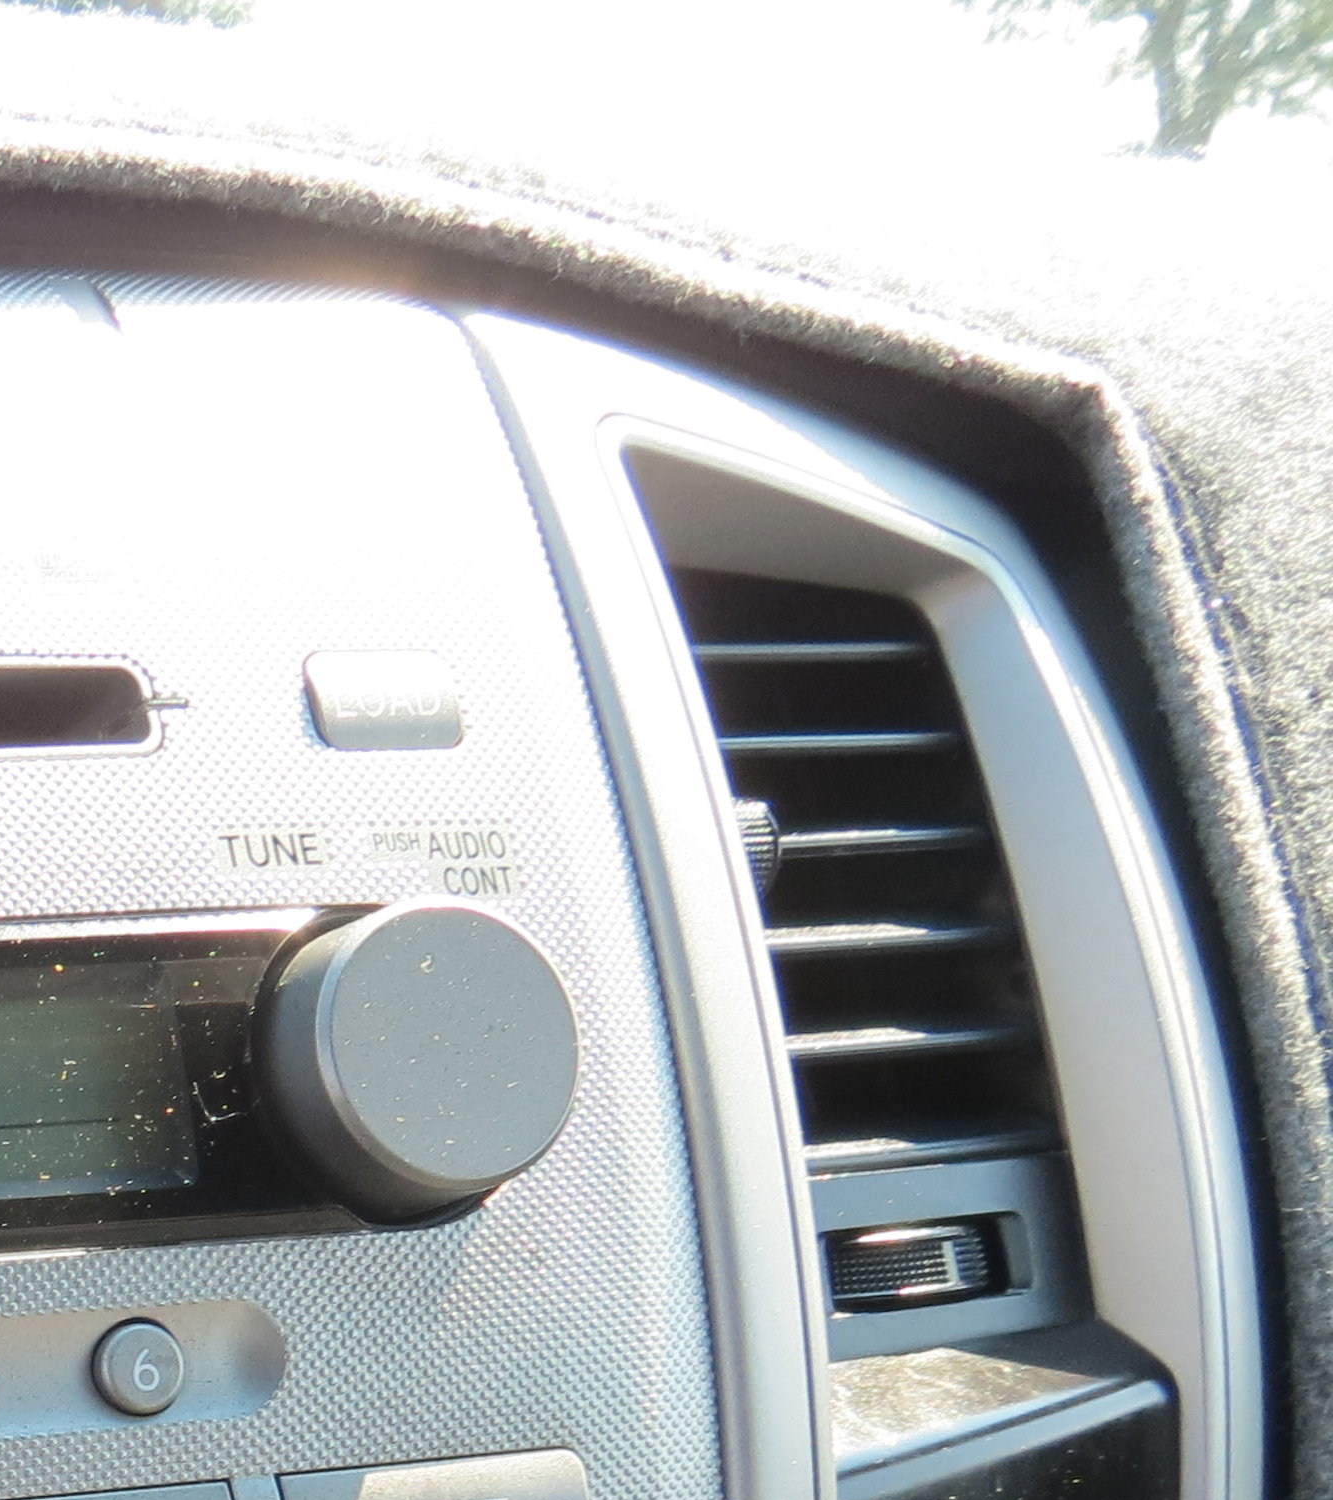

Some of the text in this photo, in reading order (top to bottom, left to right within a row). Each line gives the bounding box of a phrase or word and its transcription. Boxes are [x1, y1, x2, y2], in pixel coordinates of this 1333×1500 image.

[218, 832, 324, 868] TUNE
[372, 830, 507, 860] PUSH AUDIO
[443, 866, 514, 895] CONT
[132, 1347, 162, 1392] 6
